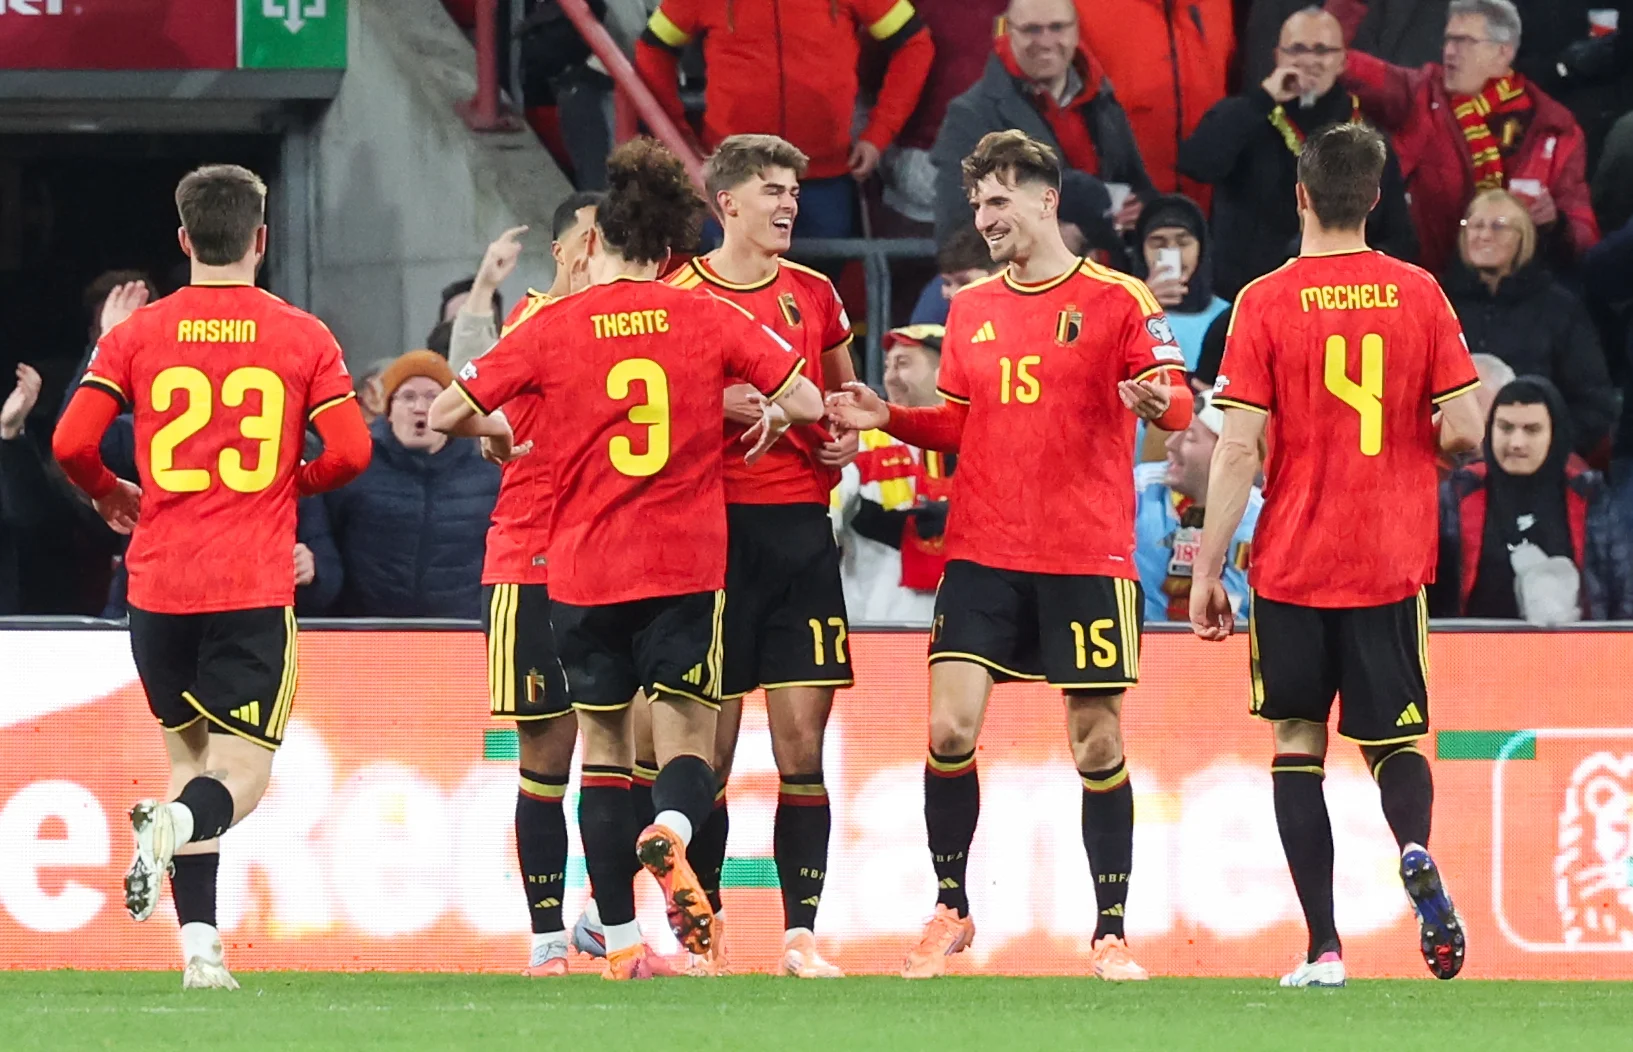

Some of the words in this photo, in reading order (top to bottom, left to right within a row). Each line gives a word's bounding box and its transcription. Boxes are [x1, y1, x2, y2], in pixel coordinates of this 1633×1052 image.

[1300, 283, 1399, 313] MECHELE
[177, 319, 256, 343] RASKIN
[590, 309, 669, 339] THEATE
[999, 355, 1041, 404] 15
[1324, 333, 1384, 456] 4
[150, 366, 285, 493] 23
[606, 358, 670, 477] 3
[808, 617, 846, 666] 17
[1070, 618, 1117, 669] 15
